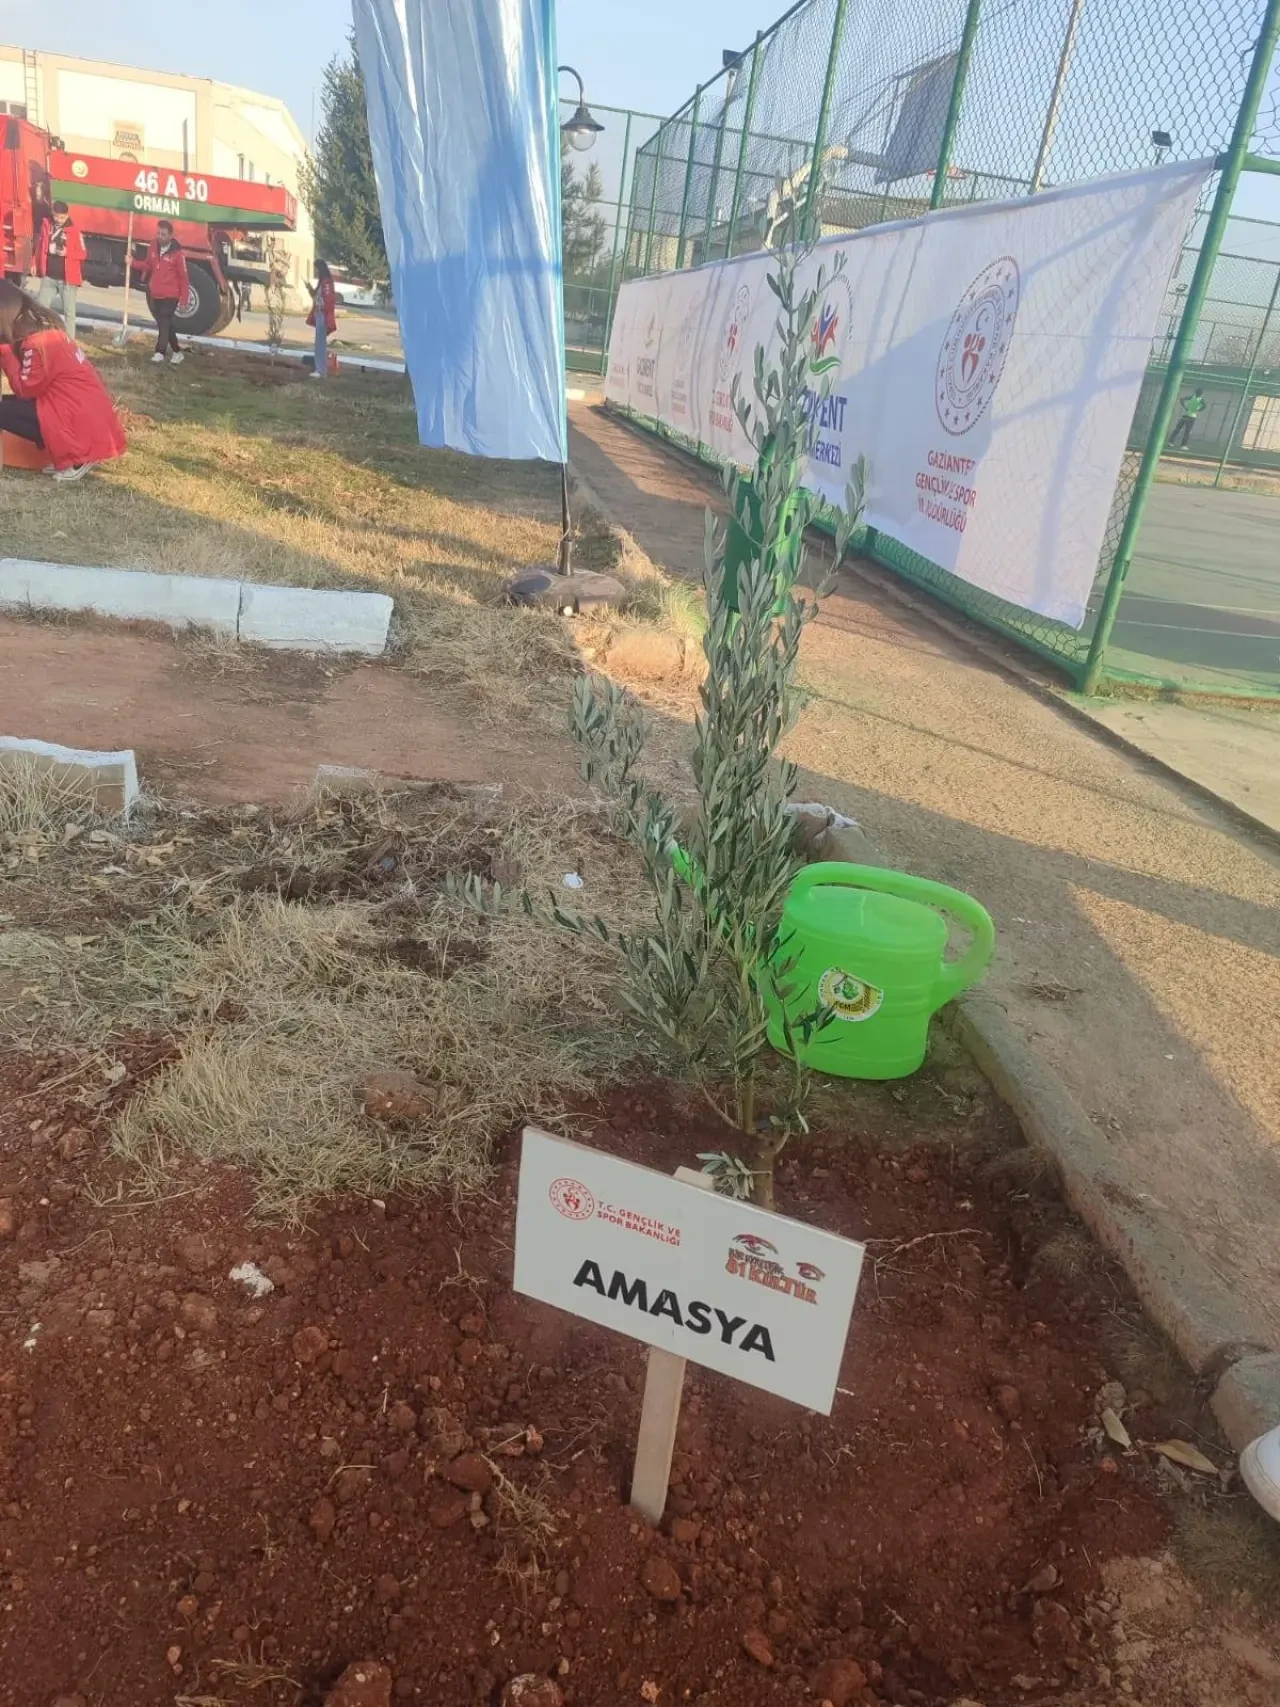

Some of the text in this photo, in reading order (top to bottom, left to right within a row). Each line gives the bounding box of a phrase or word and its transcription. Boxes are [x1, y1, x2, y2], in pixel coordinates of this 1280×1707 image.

[134, 169, 208, 202] 46 A 30
[134, 194, 180, 216] ORMAN
[814, 440, 841, 468] ERKEZİ
[954, 485, 977, 509] SPOR
[597, 1210, 681, 1247] SPOR BAKANLIĞI
[598, 1200, 682, 1238] T.C. GENÇLİK VE
[573, 1259, 776, 1363] AMASYA
